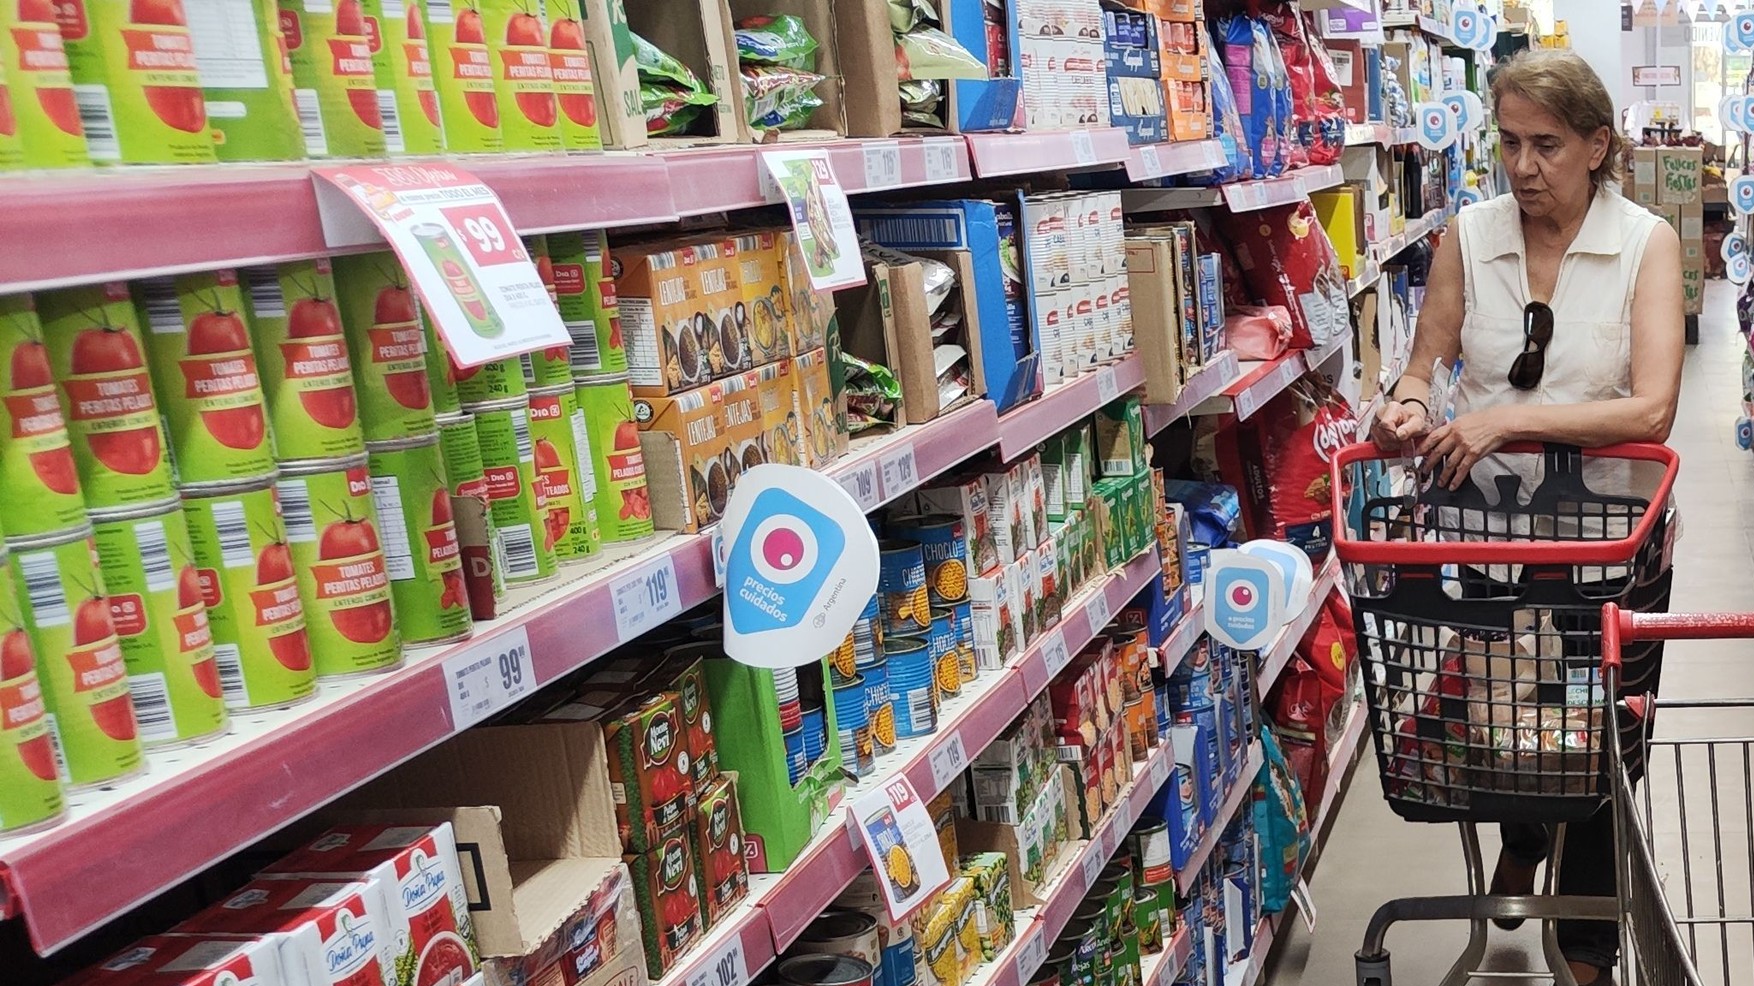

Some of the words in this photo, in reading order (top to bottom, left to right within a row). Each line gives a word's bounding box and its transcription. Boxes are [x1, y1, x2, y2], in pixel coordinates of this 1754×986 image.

[463, 216, 506, 253] 99
[924, 540, 959, 562] CHOCLO
[339, 561, 374, 579] TOMATES
[644, 574, 667, 607] 119
[739, 588, 788, 622] cuidados
[744, 576, 786, 606] precios
[824, 578, 847, 611] Argentina
[500, 648, 523, 685] 99
